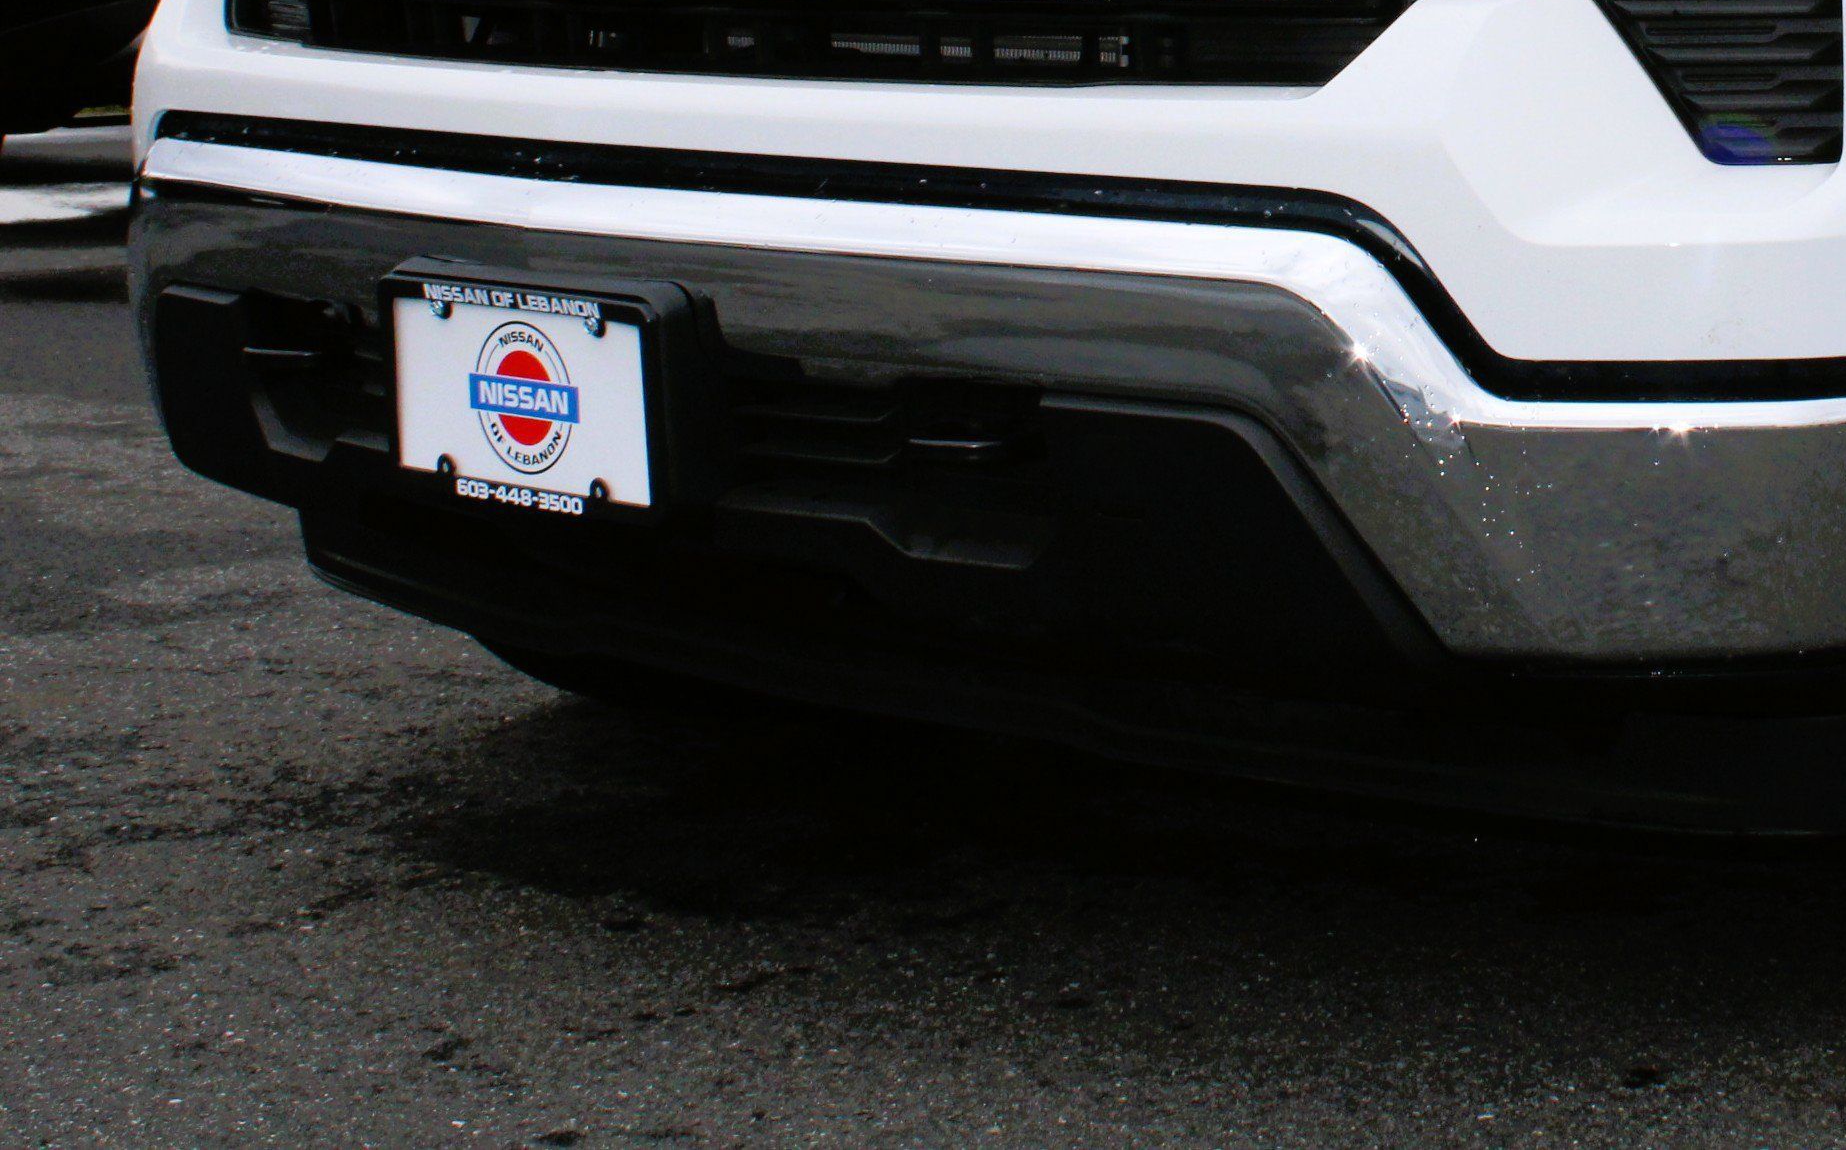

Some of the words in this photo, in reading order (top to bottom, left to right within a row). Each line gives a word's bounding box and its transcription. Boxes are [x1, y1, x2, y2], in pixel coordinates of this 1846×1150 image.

[424, 283, 490, 306] NISSAN
[492, 292, 513, 308] OF
[516, 295, 601, 320] LEBANON
[497, 331, 544, 353] NISSAN
[478, 380, 570, 416] NISSAN
[490, 423, 504, 444] OF
[506, 431, 563, 466] LEBANON
[456, 478, 584, 516] 603-448-3500
